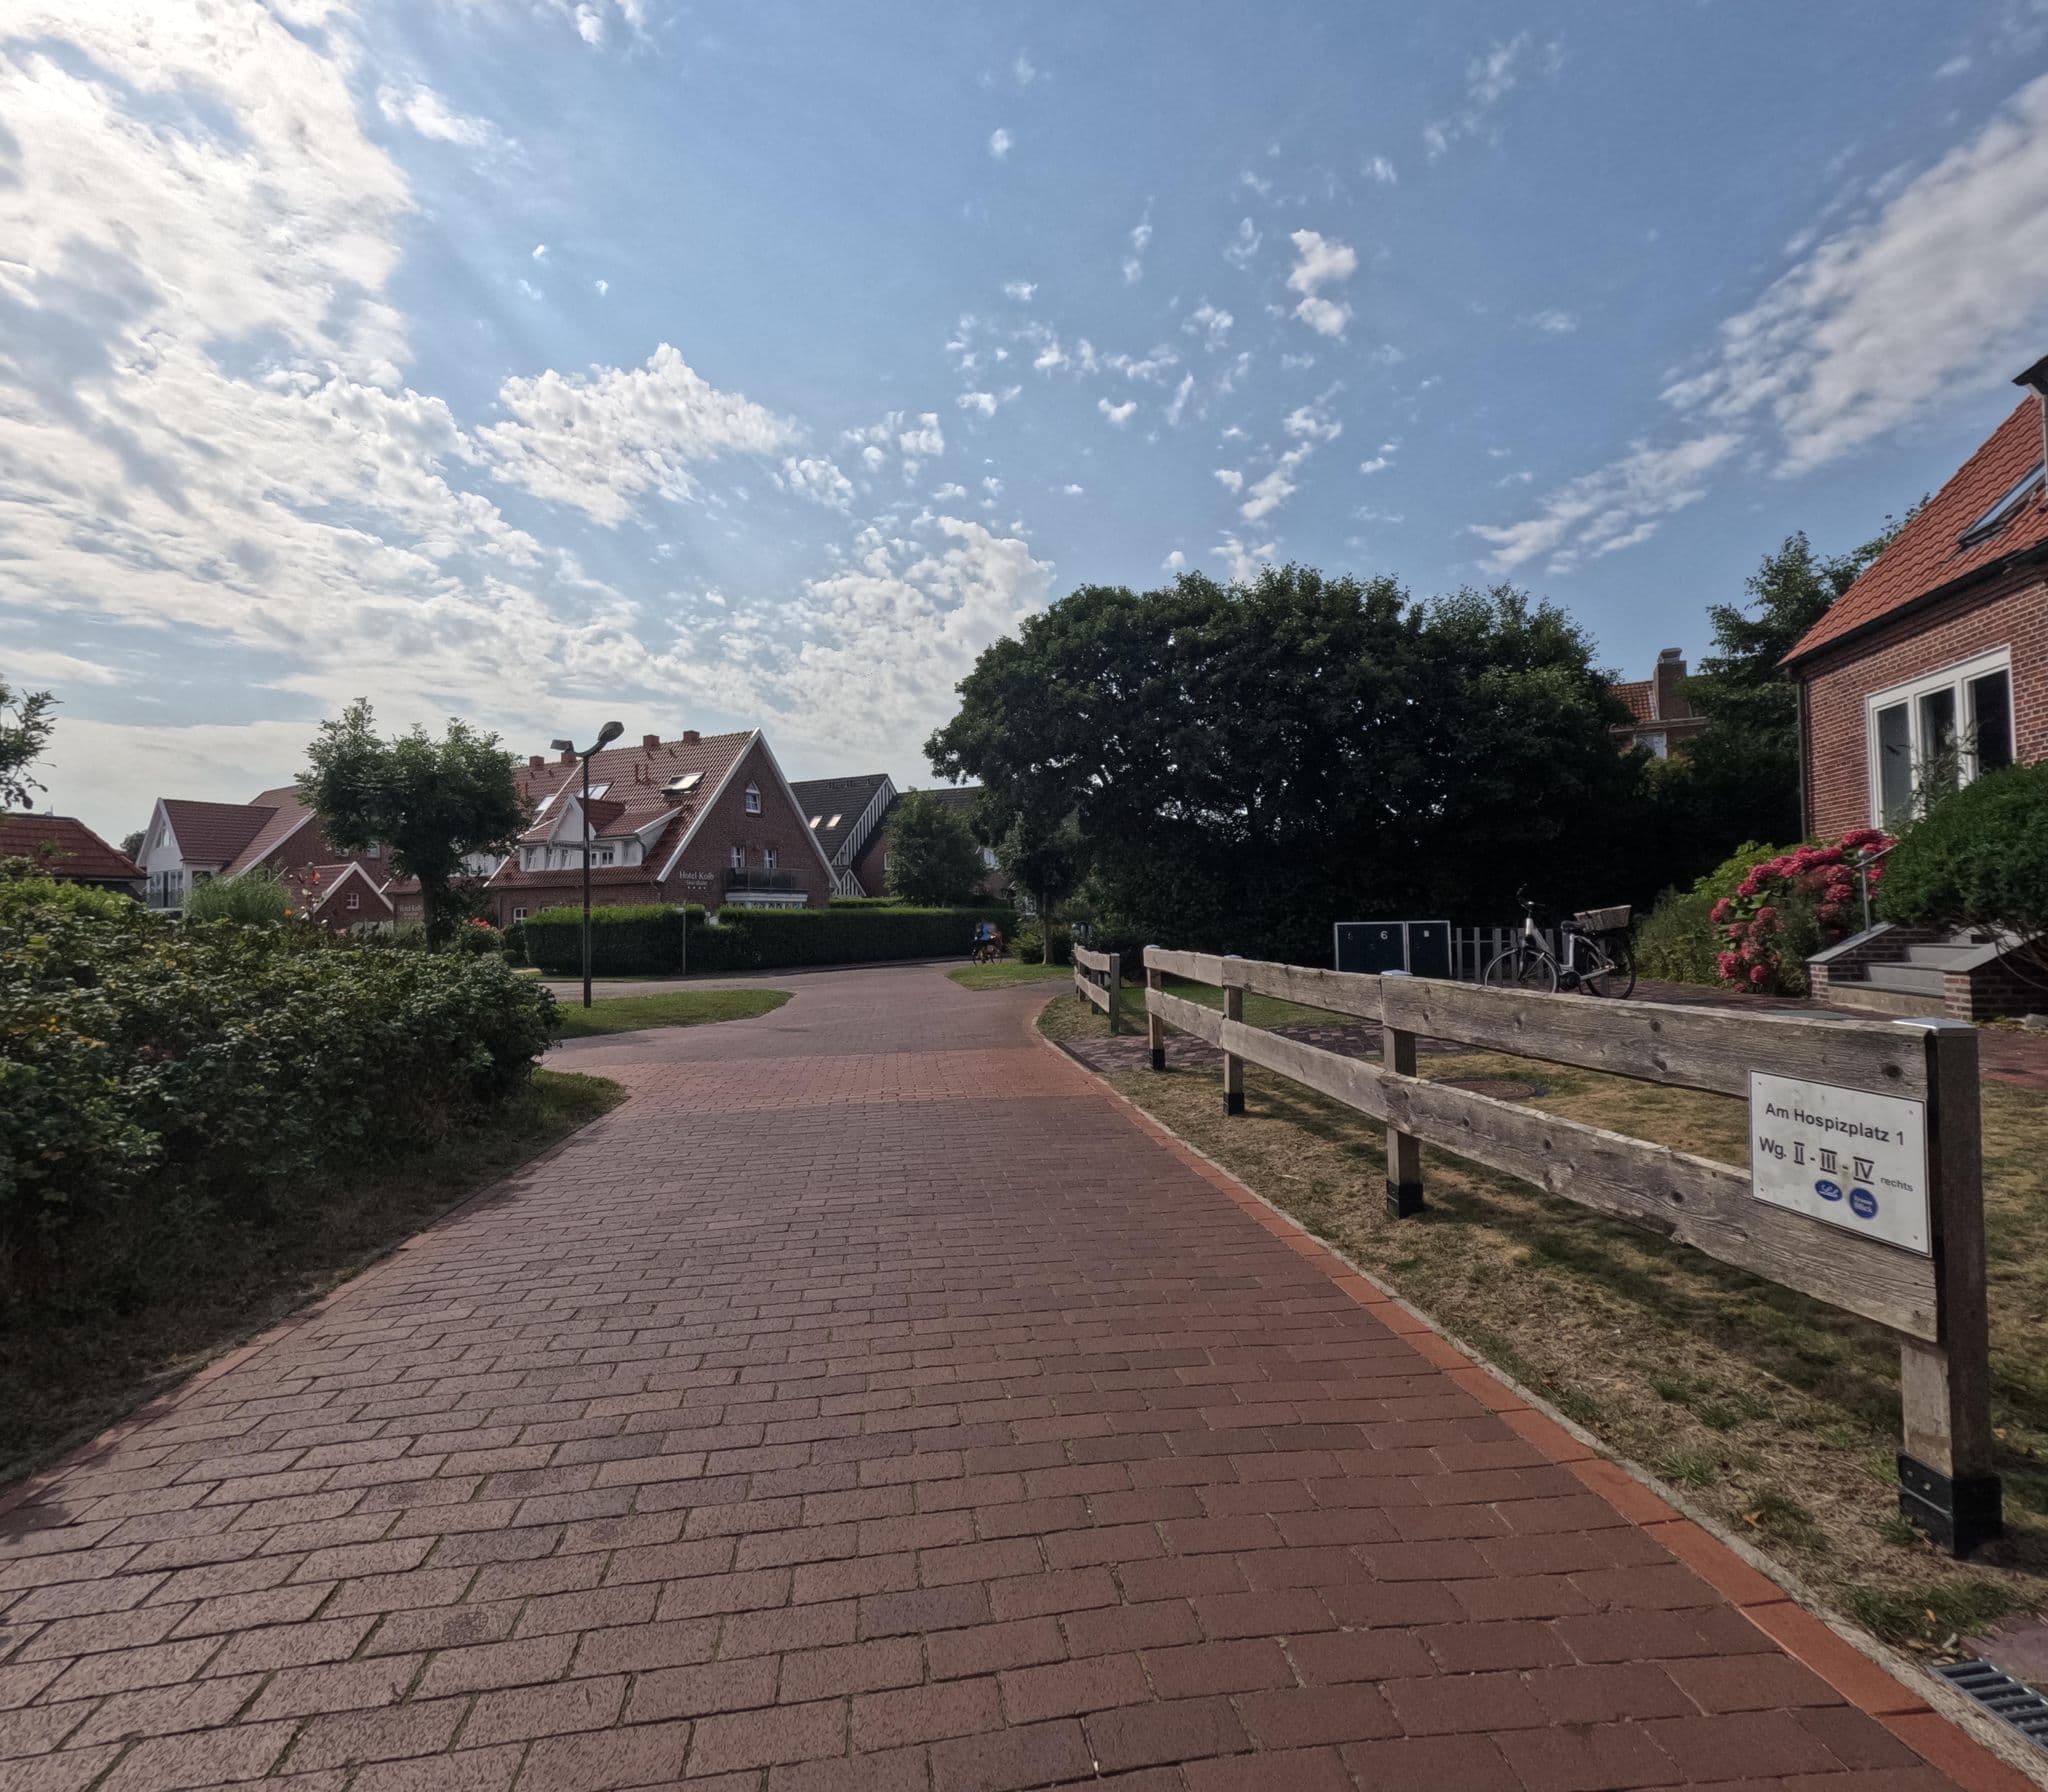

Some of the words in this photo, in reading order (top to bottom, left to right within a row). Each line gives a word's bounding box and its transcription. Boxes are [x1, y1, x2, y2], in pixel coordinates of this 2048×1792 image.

[1765, 1102, 1790, 1119] Am
[1793, 1108, 1890, 1143] Hospizplatz
[1896, 1131, 1904, 1146] 1
[1759, 1136, 1787, 1160] Wg.
[1793, 1141, 1806, 1166] II
[1819, 1147, 1838, 1175] III
[1852, 1156, 1875, 1186] IV
[1880, 1177, 1914, 1192] rechts
